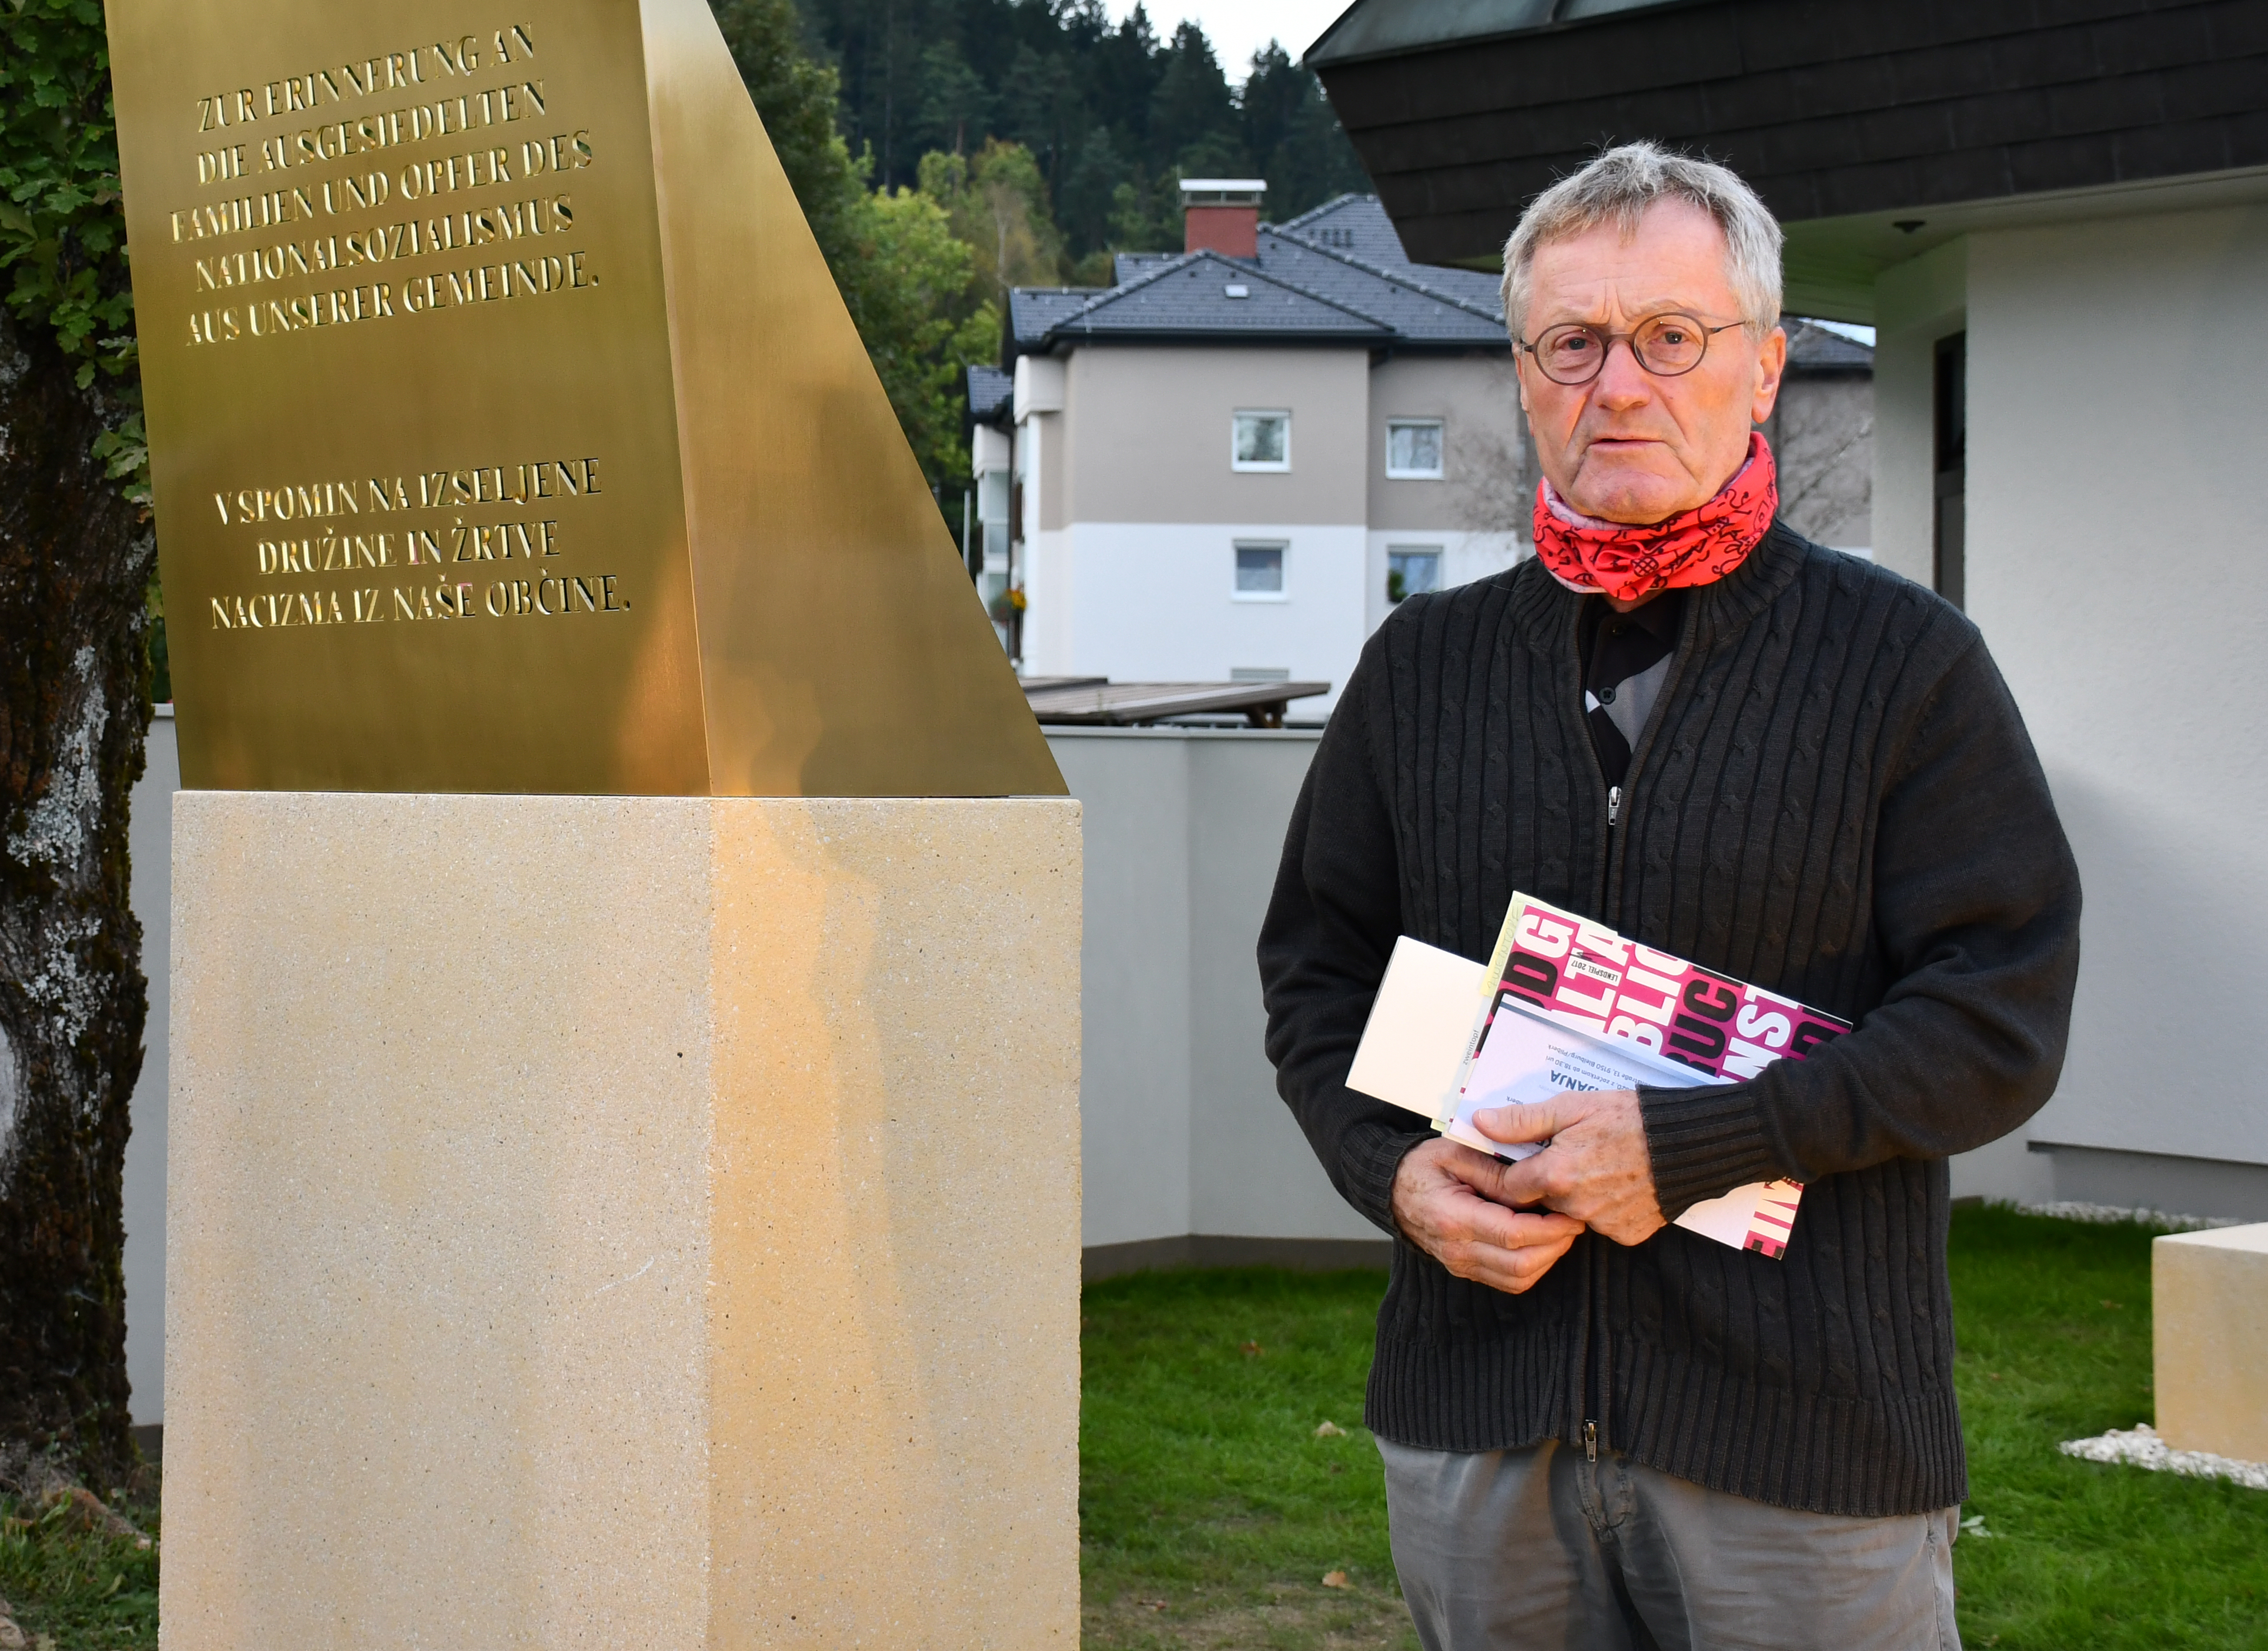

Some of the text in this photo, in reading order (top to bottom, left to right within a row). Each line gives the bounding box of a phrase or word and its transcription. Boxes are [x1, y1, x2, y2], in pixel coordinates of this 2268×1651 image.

[198, 22, 534, 133] ZUR ERINNERUNG AN
[196, 79, 546, 186] DIE AUSGESIEDELTEN
[169, 129, 594, 244] FAMILIEN UND OPFER DES
[195, 193, 573, 293] NATIONALSOZIALISMUS
[185, 250, 600, 347] AUS UNSERER GEMEINDE.
[213, 457, 603, 525] V SPOMIN NA IZSELJENE
[256, 514, 561, 576] DRUŽINE IN ŽRTVE
[209, 566, 631, 629] NACIZMA IZ NAŠE OBČINE.
[1571, 960, 1618, 982] LENDSPIEL 2017
[1463, 1030, 1479, 1065] zweintopf
[1555, 1060, 1571, 1070] 18.30
[1596, 1063, 1611, 1074] 9150
